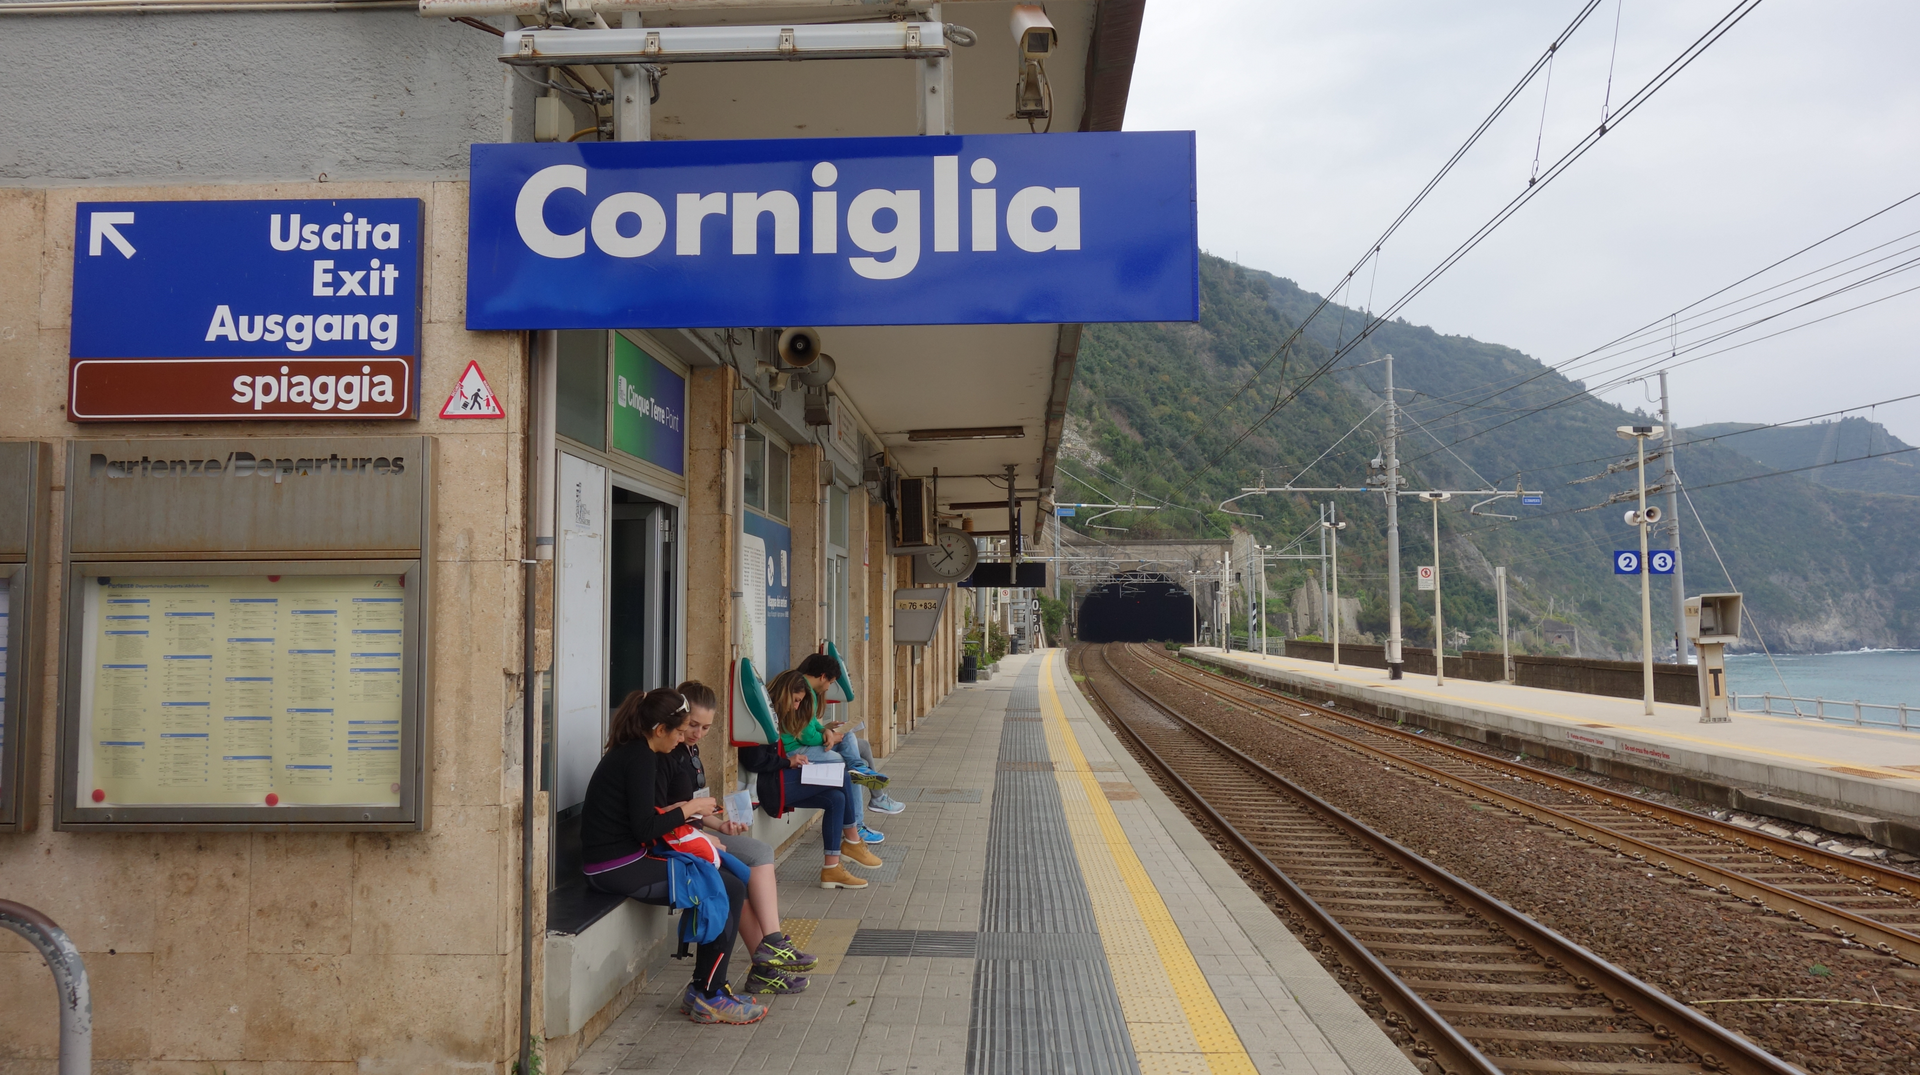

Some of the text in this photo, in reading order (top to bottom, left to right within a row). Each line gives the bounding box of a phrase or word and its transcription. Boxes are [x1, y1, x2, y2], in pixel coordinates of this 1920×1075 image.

[271, 213, 399, 250] Uscita
[516, 156, 1080, 279] Corniglia
[313, 259, 398, 296] Exit
[205, 305, 397, 351] Ausgang
[232, 366, 394, 410] spiaggia
[628, 385, 679, 432] Cinque Terre Point
[89, 451, 405, 483] Partenze/Departures
[1623, 556, 1633, 568] 2
[1658, 556, 1667, 568] 3
[1709, 668, 1722, 696] T
